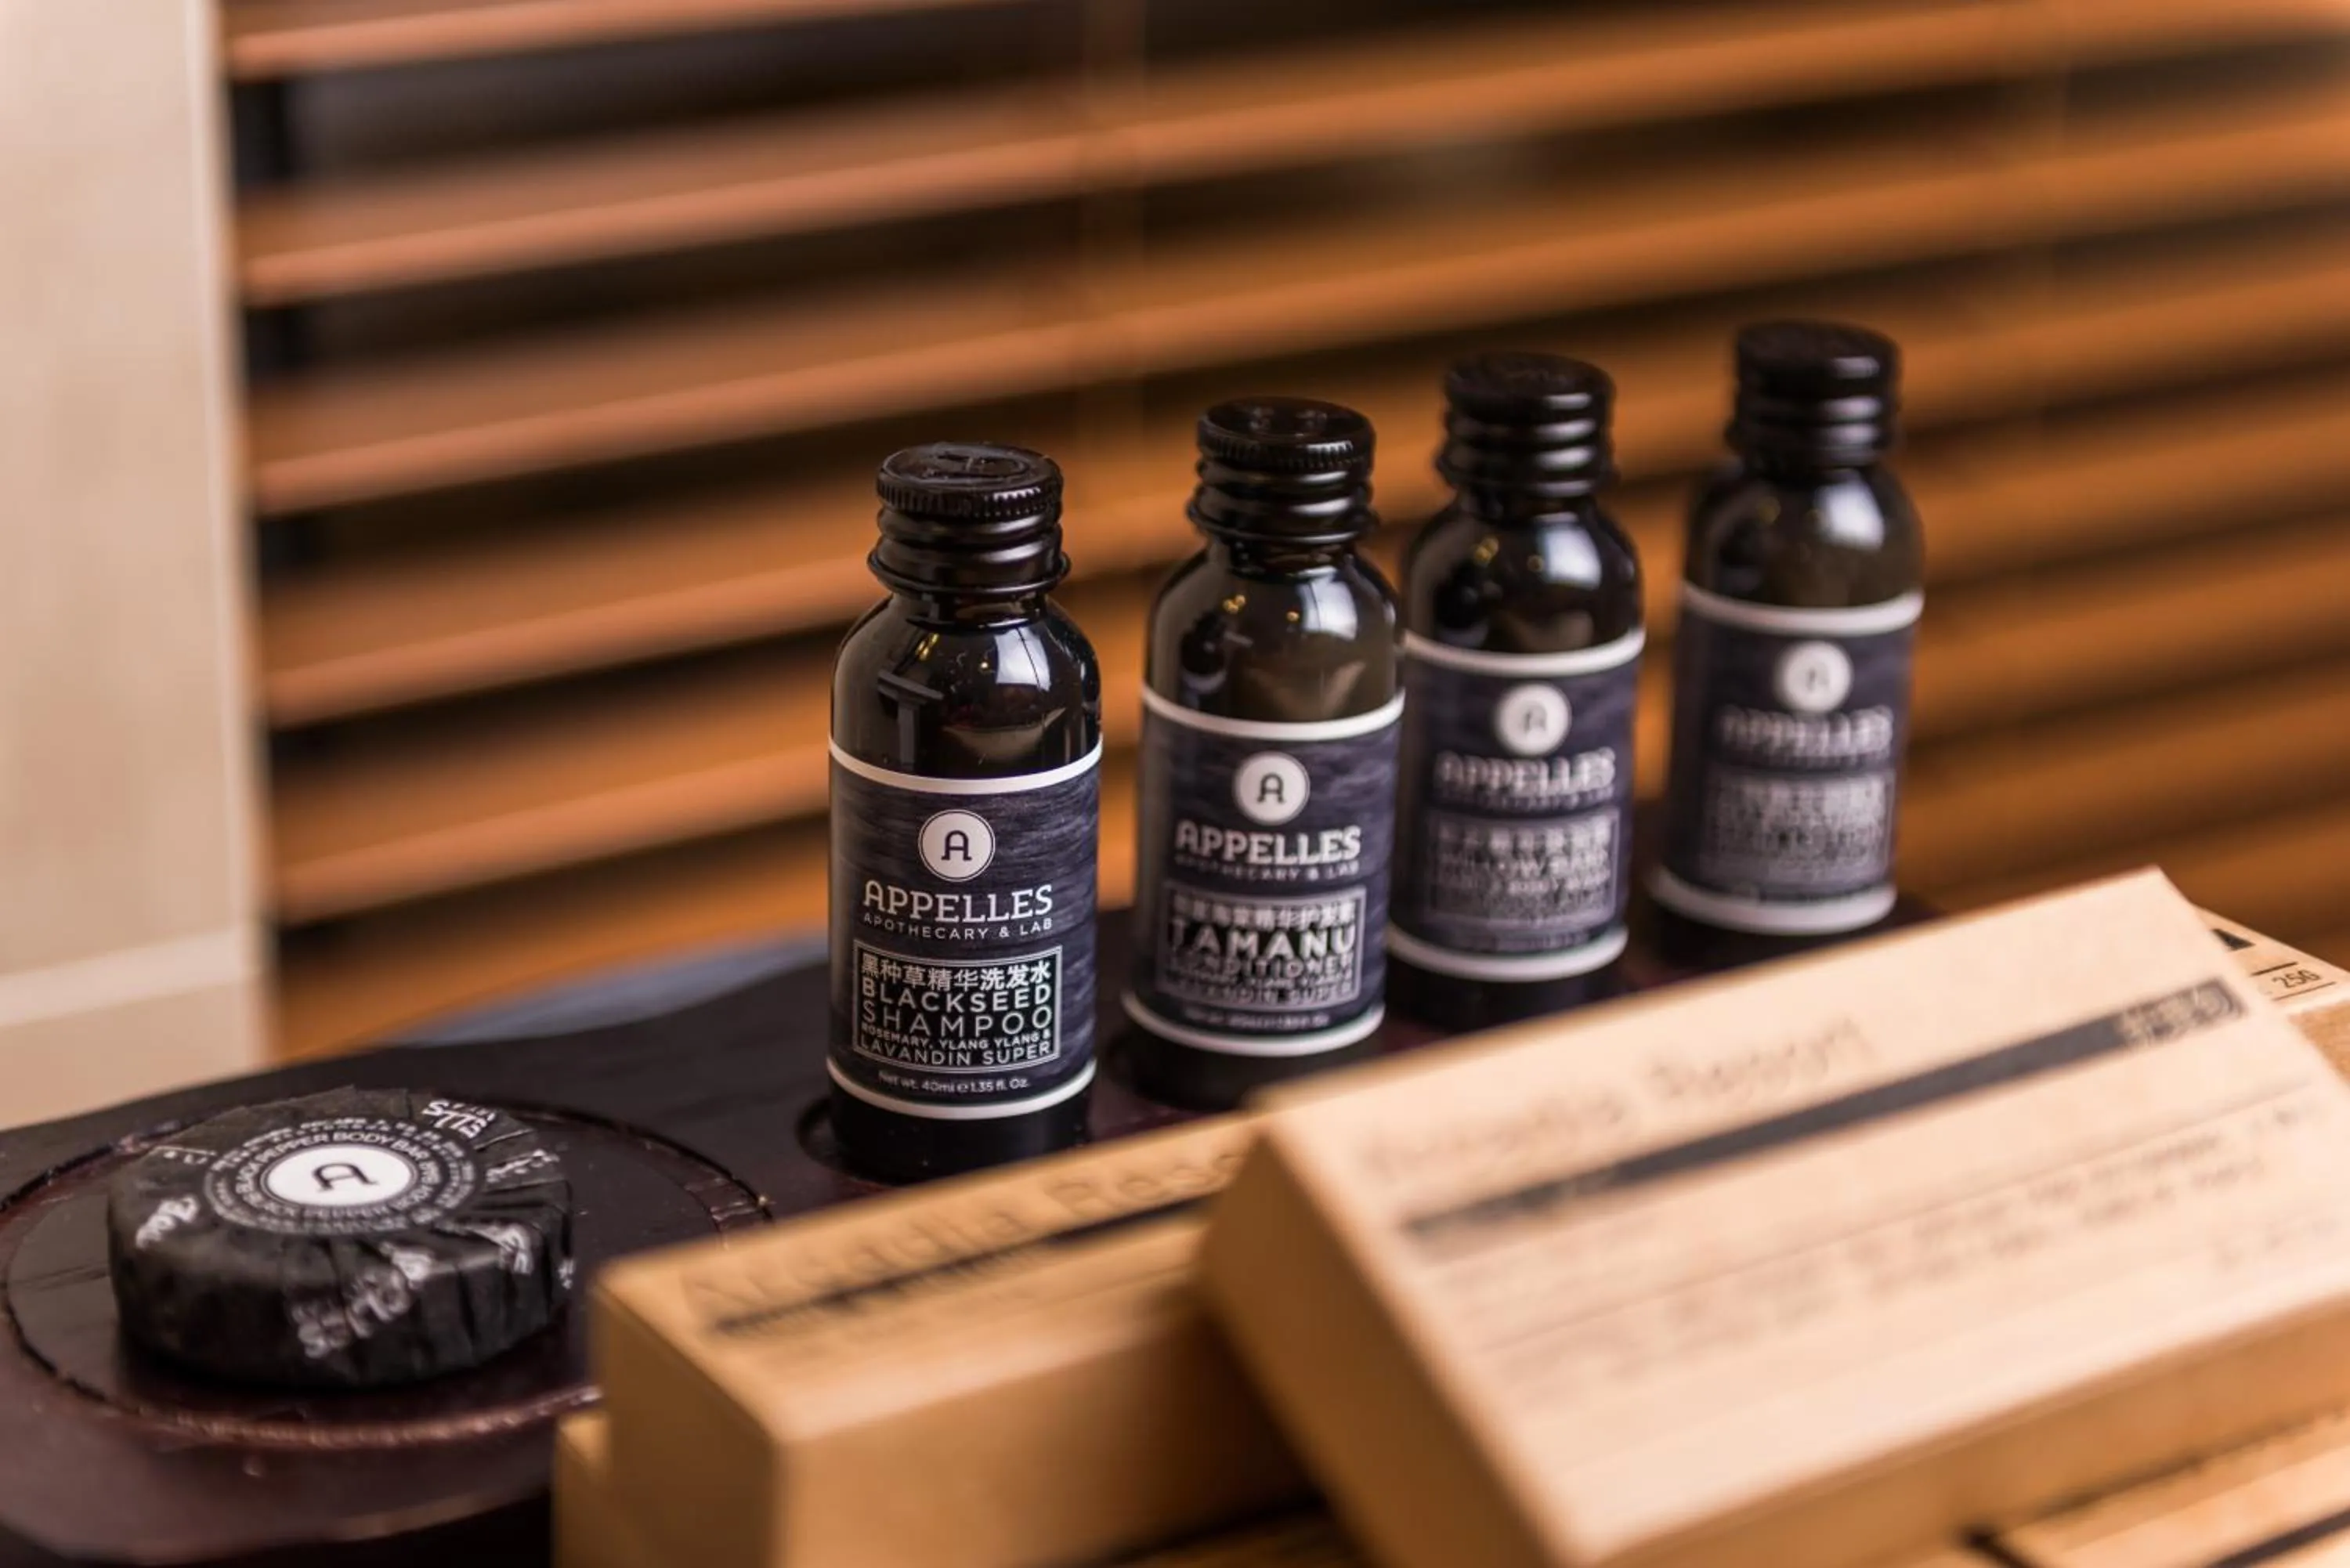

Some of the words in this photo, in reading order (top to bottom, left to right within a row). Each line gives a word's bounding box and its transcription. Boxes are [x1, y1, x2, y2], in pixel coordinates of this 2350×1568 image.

[1256, 772, 1285, 803] A
[941, 829, 973, 861] A
[1177, 820, 1362, 866] APPELLES
[863, 880, 1054, 923] APPELLES
[863, 911, 989, 941] APOTHECARY
[999, 926, 1010, 938] &
[1019, 917, 1053, 936] LAB
[1173, 917, 1356, 962] TAMANU
[862, 952, 1052, 992] 黑种草精华洗发水
[862, 977, 1052, 1013] BLACKSEED
[862, 999, 1053, 1039] SHAMPOO
[862, 1022, 934, 1050] ROSEMARY,
[940, 1039, 989, 1050] YLANG
[994, 1031, 1039, 1048] YLANG
[862, 1037, 971, 1067] LAVANDIN
[982, 1040, 1050, 1065] SUPER
[332, 1131, 393, 1144] BODY
[312, 1162, 381, 1191] A
